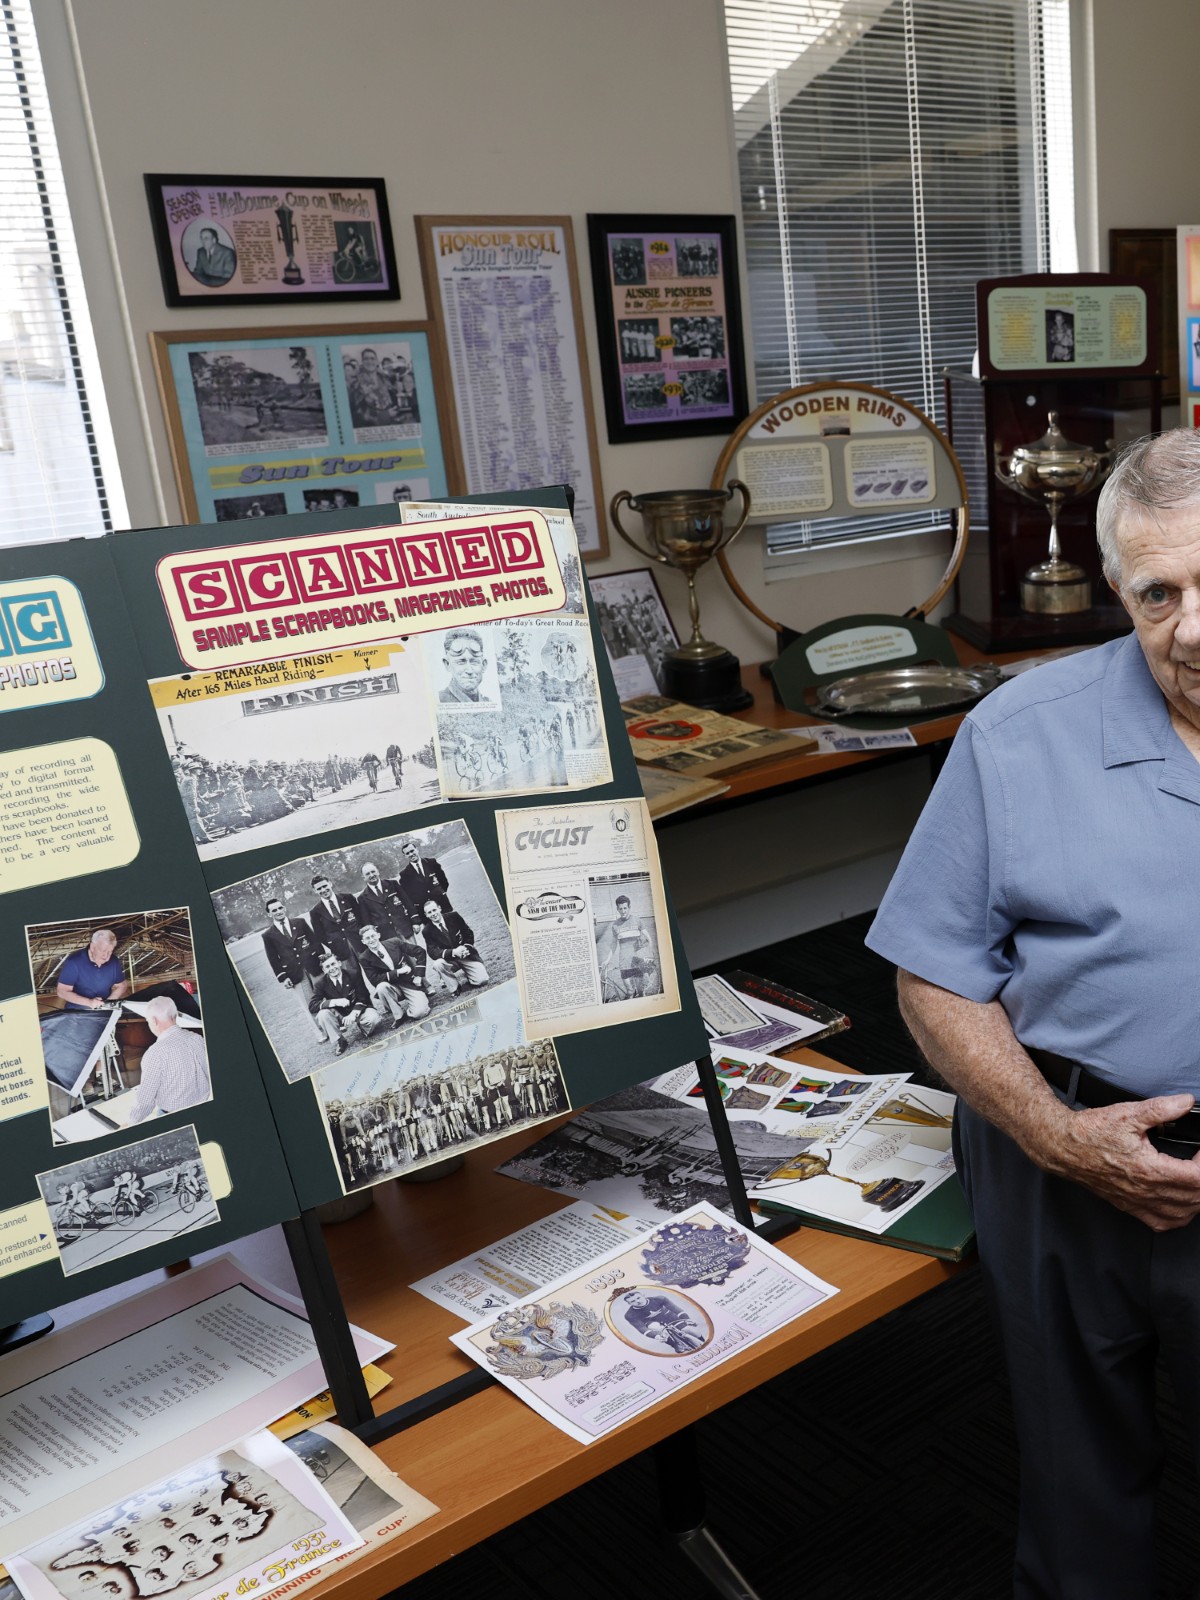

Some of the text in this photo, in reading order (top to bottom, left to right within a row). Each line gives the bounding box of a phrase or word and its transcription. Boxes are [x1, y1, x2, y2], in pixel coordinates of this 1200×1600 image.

[166, 190, 202, 209] SEASON
[217, 192, 328, 217] Melbourne Cup on
[170, 205, 204, 224] OPENER
[439, 232, 561, 256] HONOUR ROLL
[461, 244, 543, 266] Sun Tour
[625, 287, 713, 299] AUSSIE PIONEERS
[761, 396, 907, 434] WOODEN RIMS
[239, 455, 401, 484] Sun Tour
[417, 511, 437, 519] South
[186, 529, 534, 612] SCANNED
[192, 576, 553, 652] SAMPLE SCRAPBOOKS, MAGAZINES, PHOTOS.
[495, 618, 573, 627] of To-day's Great Road
[215, 649, 378, 681] REMARKABLE FINISH Winner
[176, 667, 316, 700] After 165 Miles Hard Riding
[252, 673, 393, 712] FINISH
[15, 754, 91, 775] of recording all
[11, 765, 95, 787] to digital format
[15, 776, 92, 797] and transmitted.
[3, 795, 50, 809] recording
[79, 784, 100, 795] wide
[3, 821, 26, 832] have
[29, 815, 52, 827] been
[56, 807, 93, 821] donated
[12, 802, 69, 819] scrapbooks.
[533, 815, 575, 826] The Australian
[25, 815, 109, 838] have been loaned
[36, 824, 112, 846] The content of
[514, 825, 594, 851] CYCLIST
[5, 856, 15, 864] to
[21, 852, 33, 861] be
[51, 845, 71, 854] very
[76, 835, 115, 848] valuable
[559, 903, 577, 912] MONTH
[9, 1078, 34, 1090] boxes
[1, 1092, 31, 1106] stands.
[4, 1236, 38, 1253] restored
[13, 1241, 52, 1261] enhanced
[584, 1268, 626, 1294] 1898
[428, 1283, 490, 1316] SUNNY DOG SEPT 2023
[690, 1323, 752, 1369] MIDDLETON
[292, 1531, 326, 1552] 1931
[236, 1538, 342, 1595] de France
